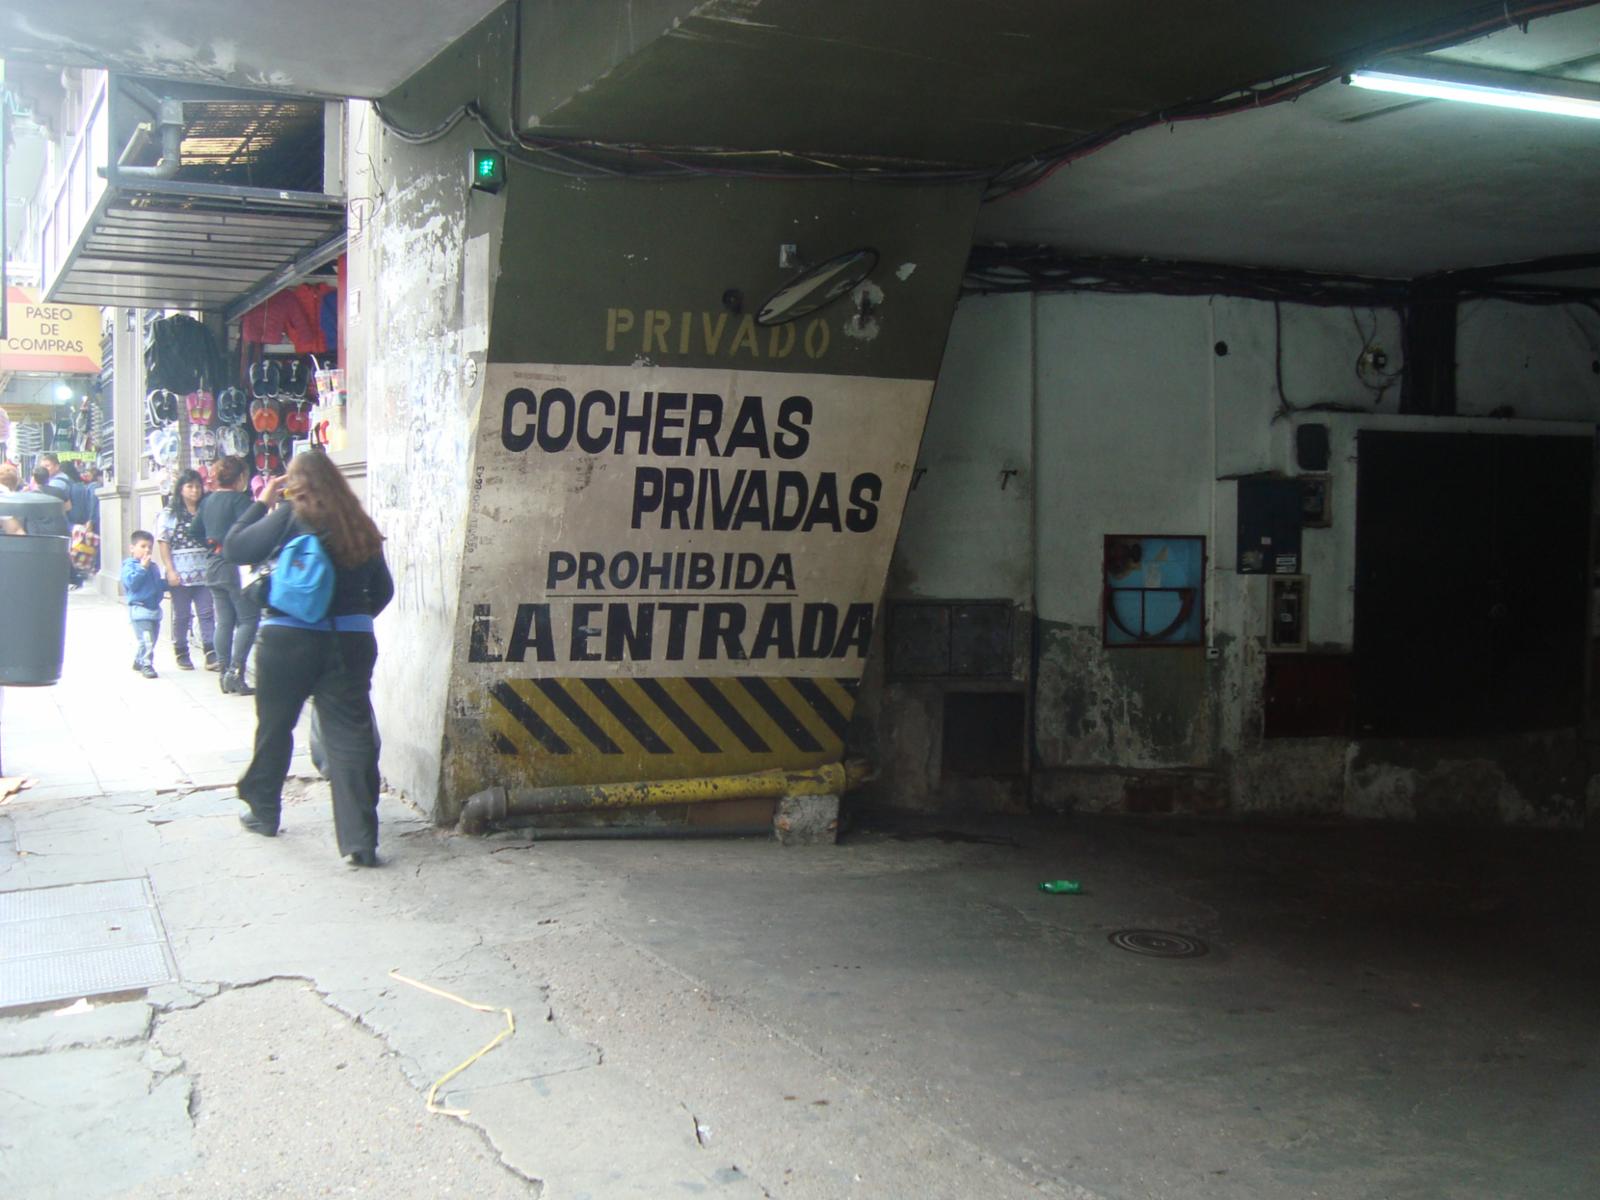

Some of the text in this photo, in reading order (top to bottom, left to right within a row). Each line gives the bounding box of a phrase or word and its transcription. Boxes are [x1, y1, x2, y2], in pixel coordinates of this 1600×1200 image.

[26, 306, 72, 320] PASEO
[40, 323, 59, 335] DE
[607, 308, 831, 359] PRIVADO
[7, 338, 83, 352] COMPRAS
[501, 388, 813, 459] COCHERAS
[631, 466, 882, 533] PRIVADAS
[546, 552, 796, 591] PROHIBIDA
[468, 602, 875, 663] LA ENTRADA
